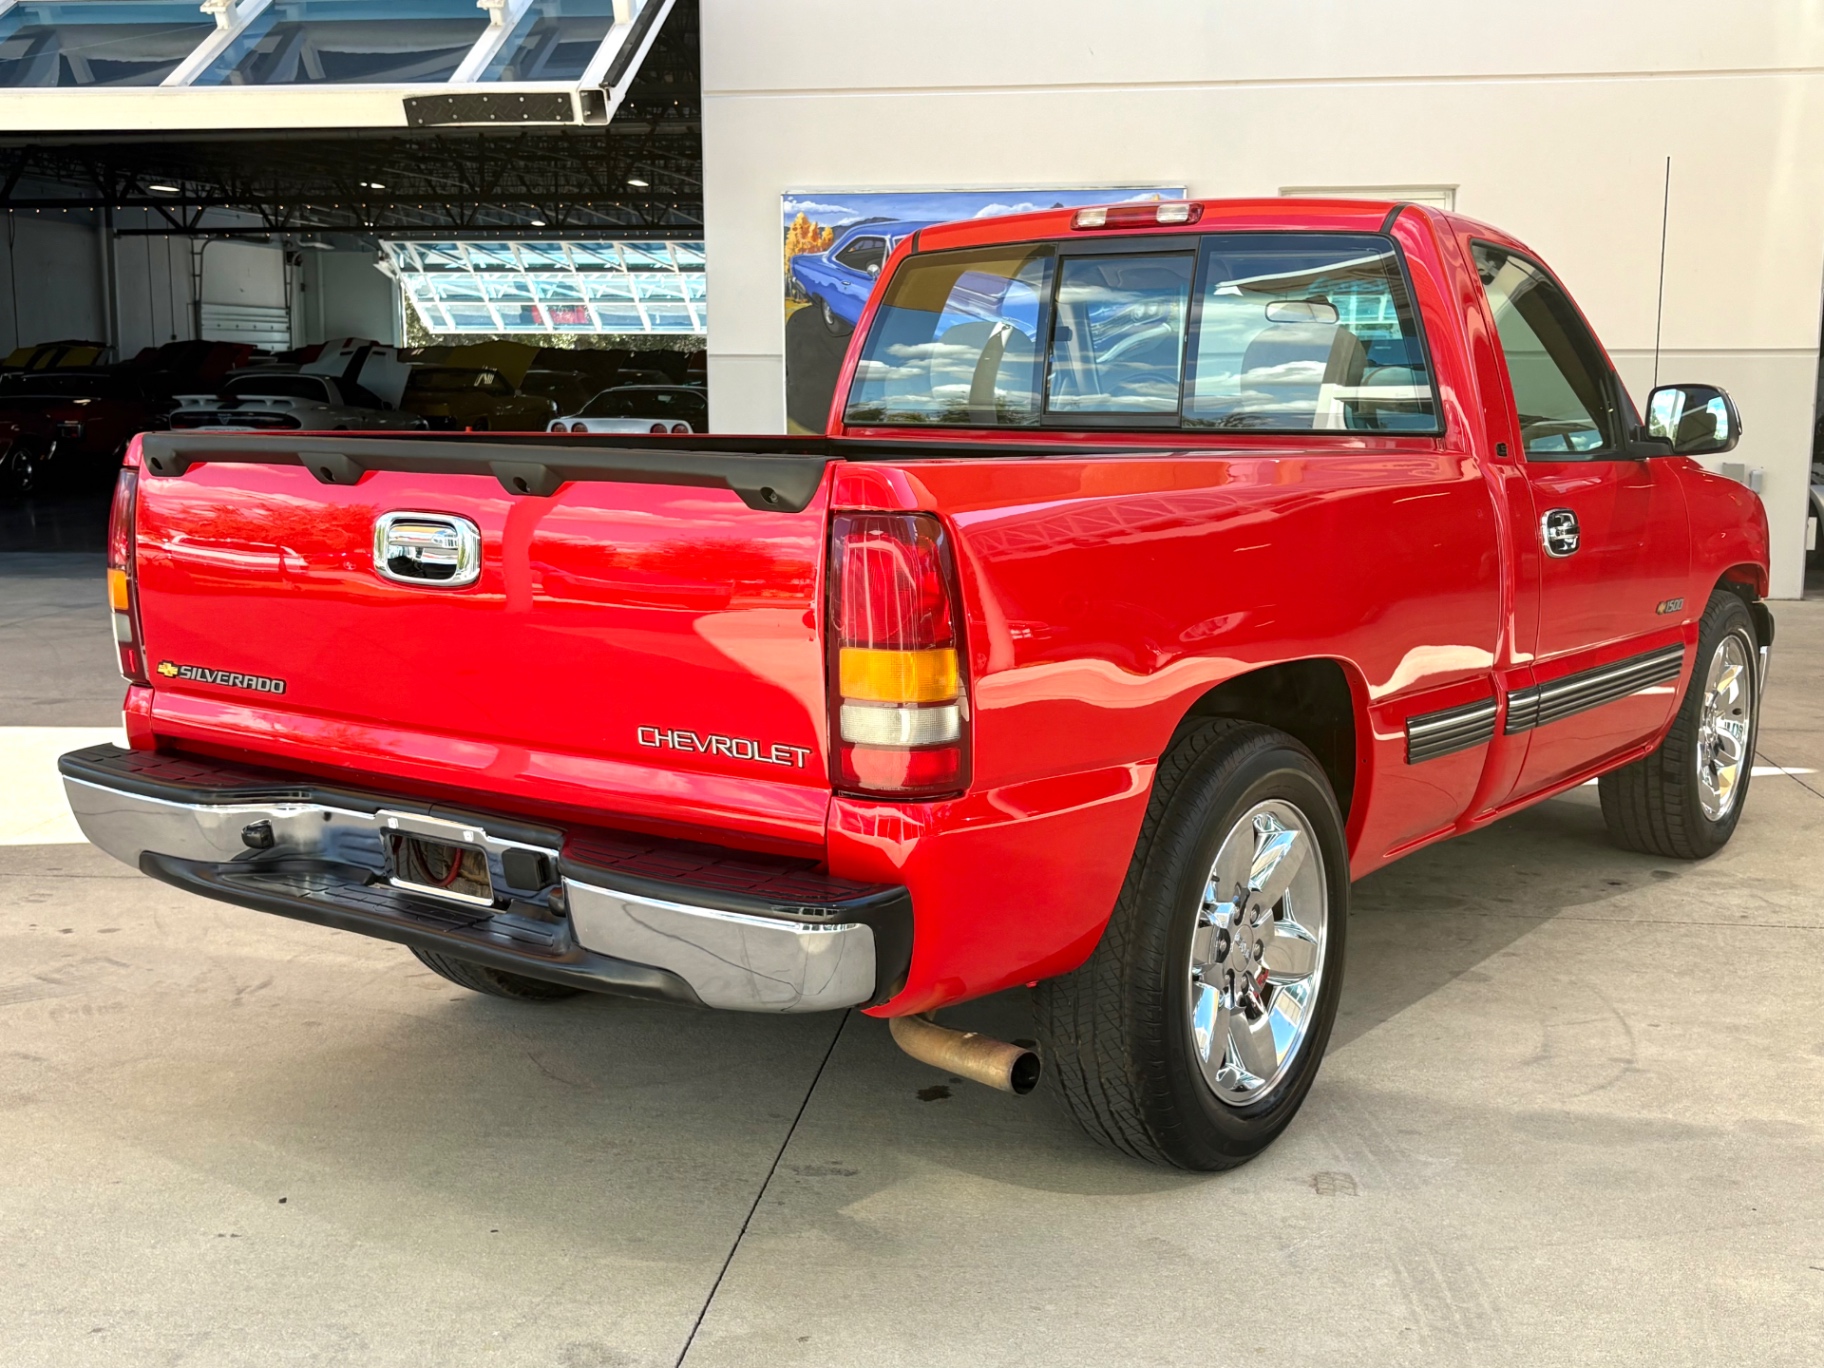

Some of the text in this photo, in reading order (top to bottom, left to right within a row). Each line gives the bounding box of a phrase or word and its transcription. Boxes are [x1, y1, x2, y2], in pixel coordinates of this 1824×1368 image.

[1665, 598, 1684, 613] 1500
[179, 665, 285, 694] SILVERADO
[637, 726, 812, 768] CHEVROLET
